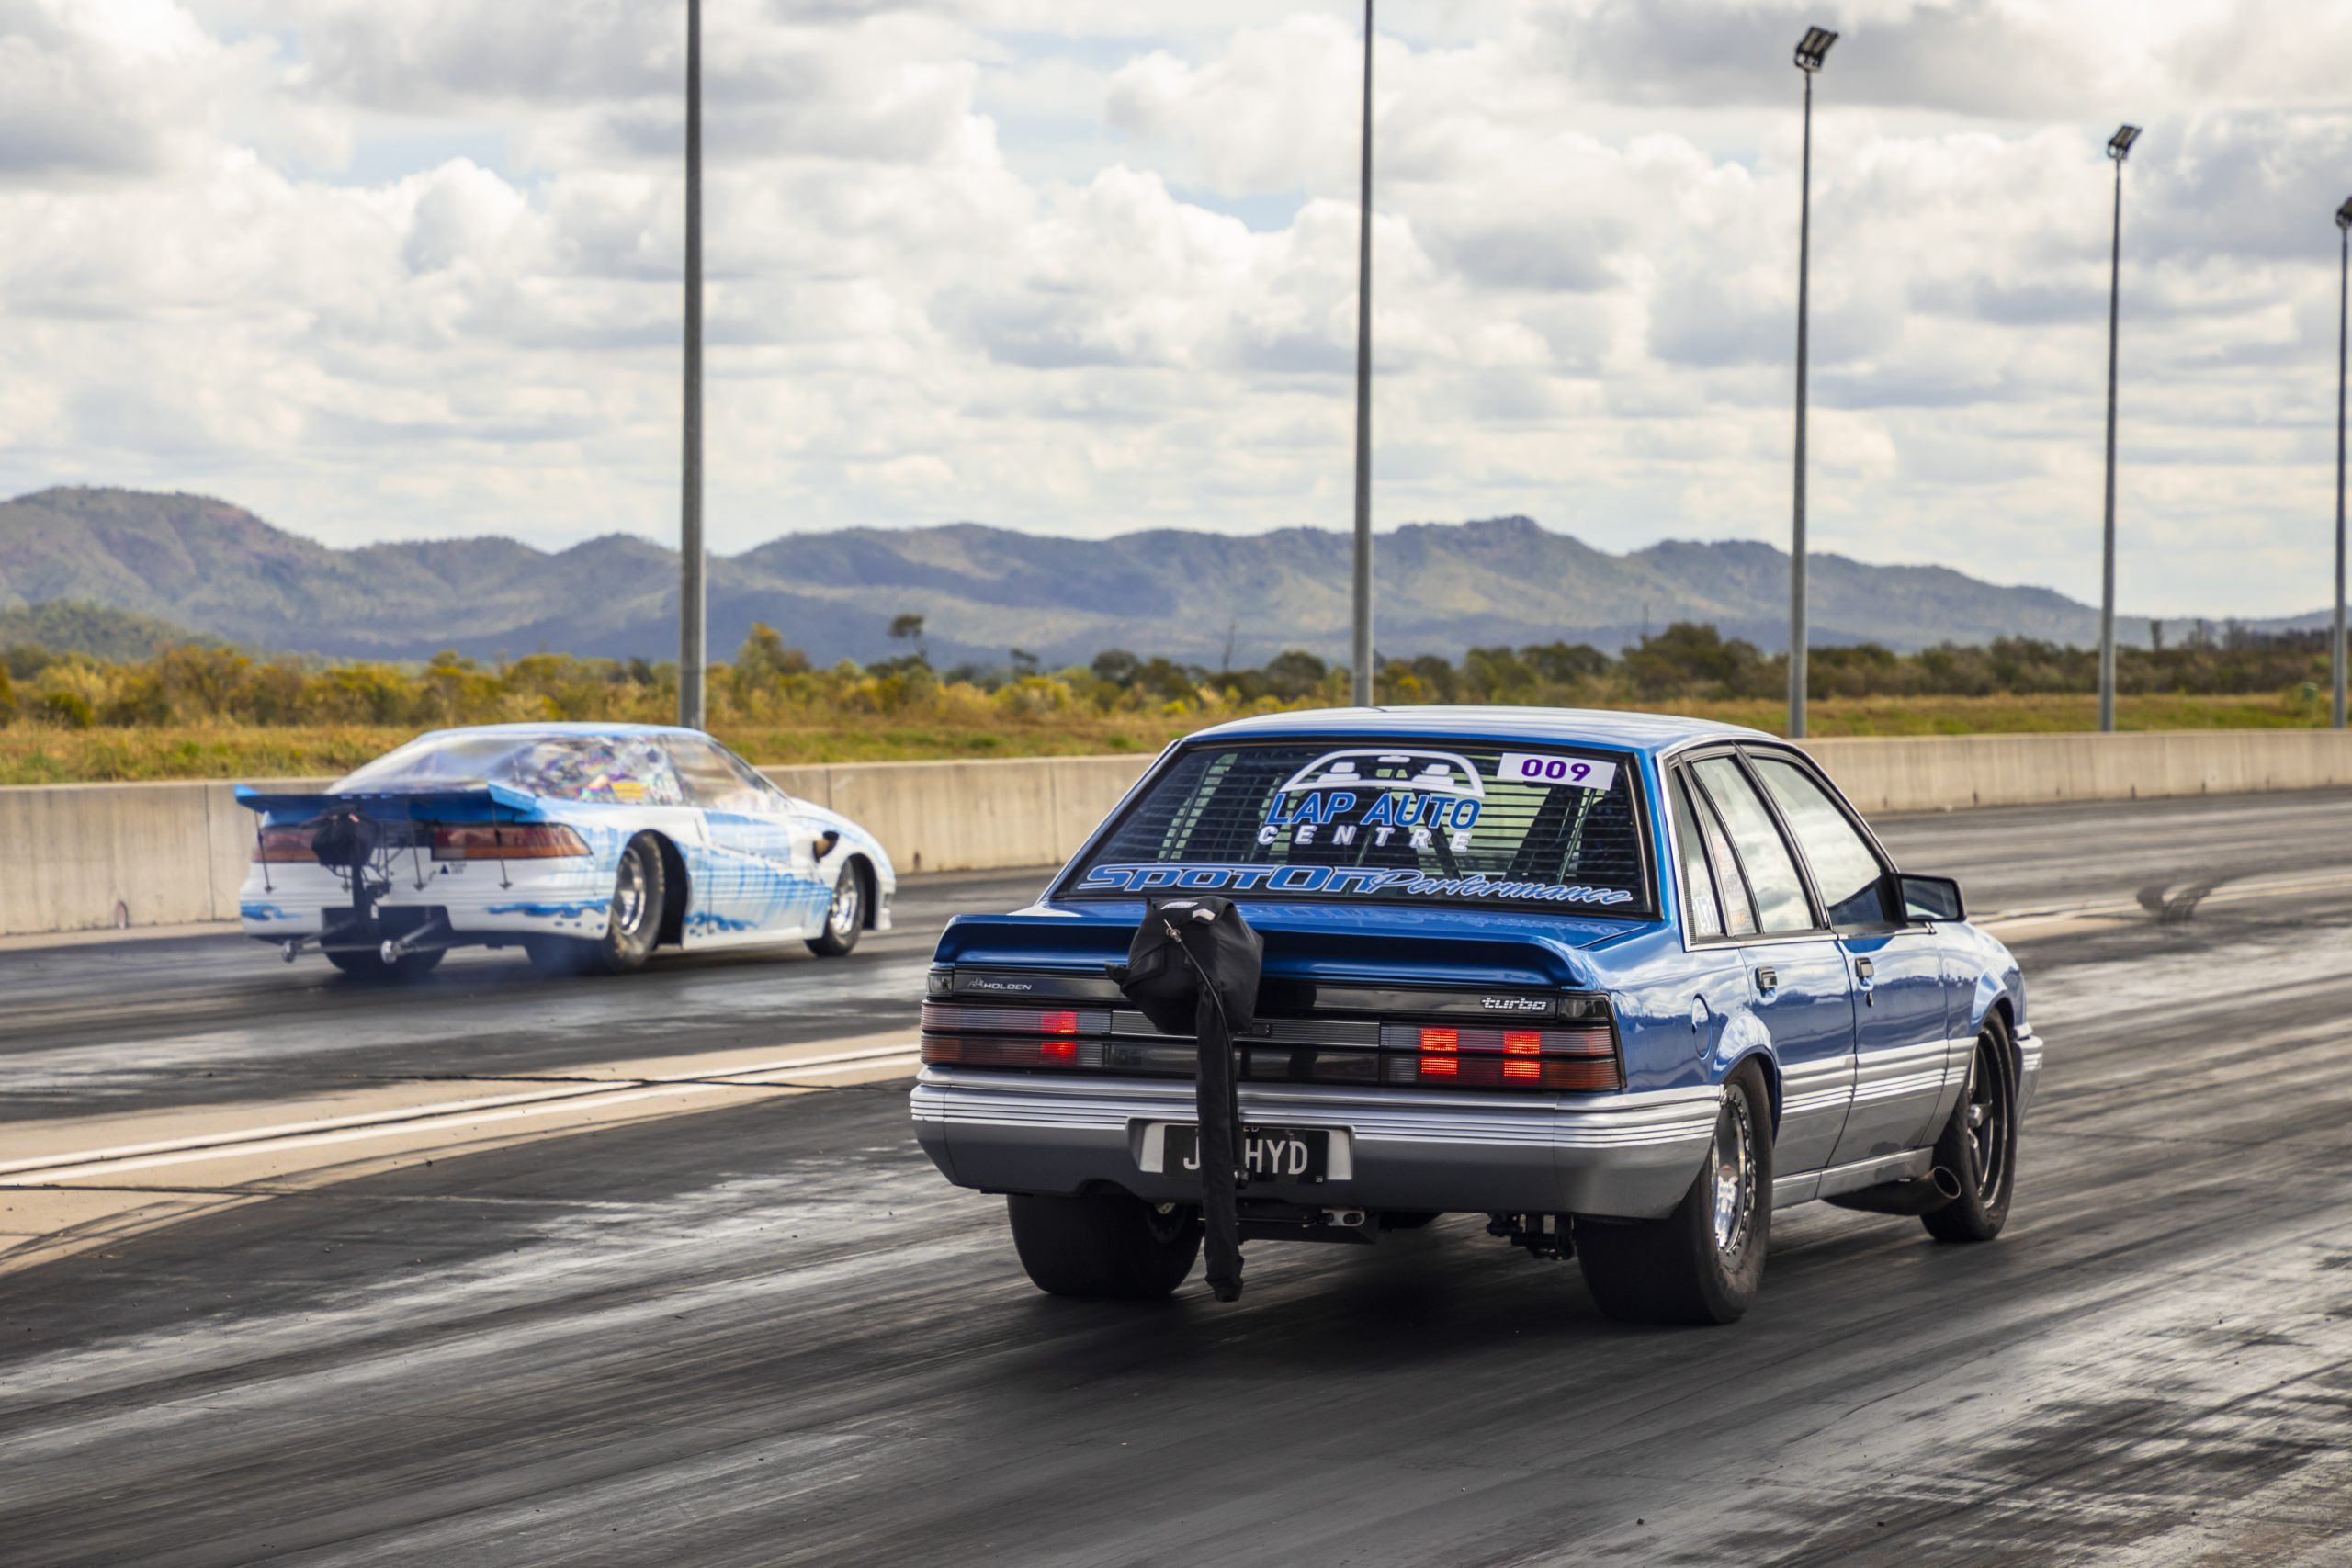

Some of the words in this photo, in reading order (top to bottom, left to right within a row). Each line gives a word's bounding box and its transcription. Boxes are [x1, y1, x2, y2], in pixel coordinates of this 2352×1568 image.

[1521, 758, 1591, 782] 009
[1264, 792, 1357, 825] LAP
[1360, 792, 1483, 830] AUTO
[1257, 825, 1474, 852] CENTRE
[1366, 868, 1634, 905] Performance
[983, 982, 1033, 991] HOLDEN
[1481, 997, 1547, 1010] turbo
